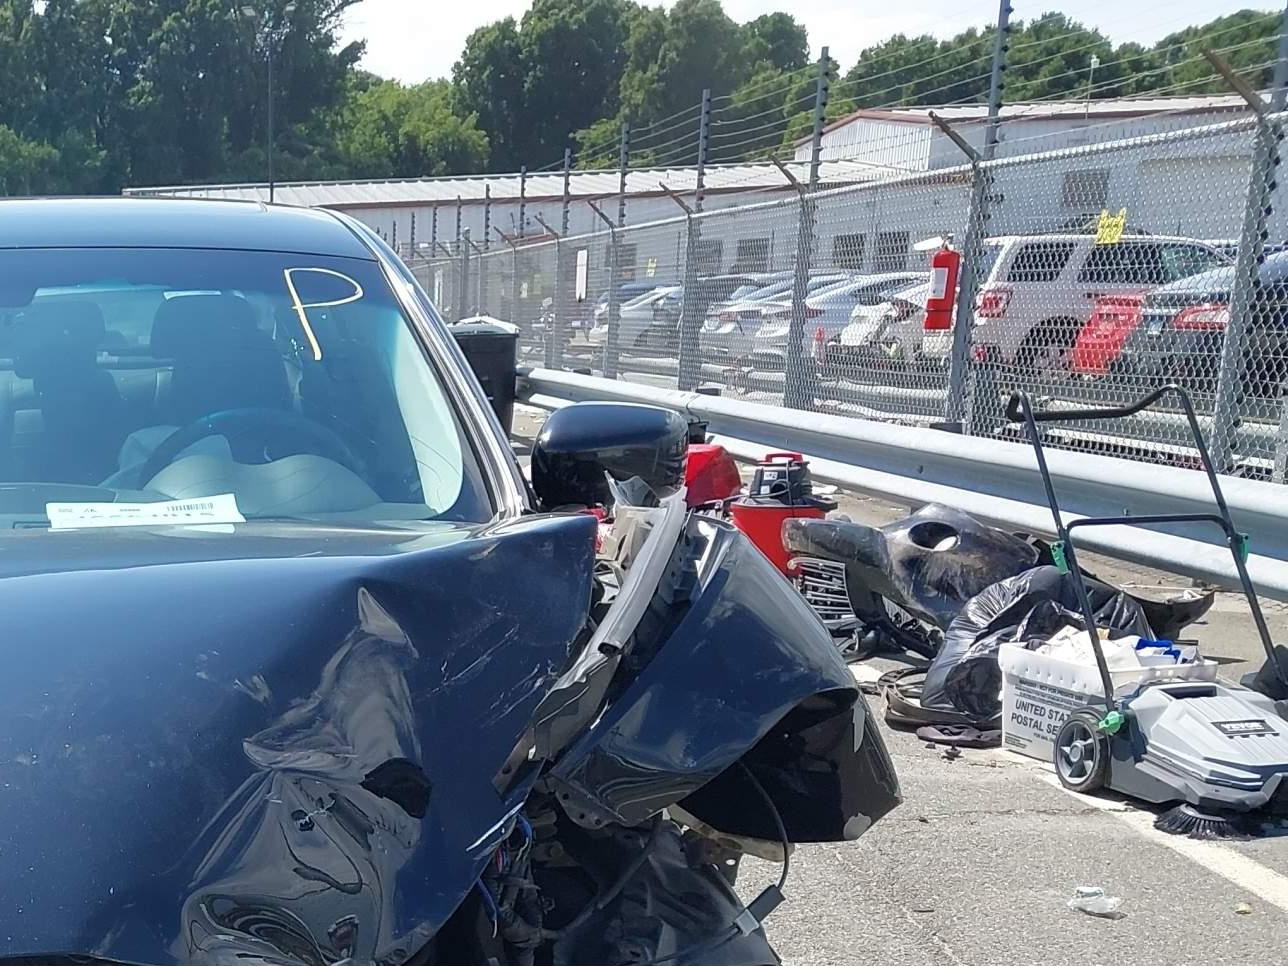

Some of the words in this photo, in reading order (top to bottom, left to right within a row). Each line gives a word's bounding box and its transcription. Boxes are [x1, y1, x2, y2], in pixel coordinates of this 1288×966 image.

[283, 267, 364, 360] P
[1011, 712, 1044, 732] POSTAL
[1015, 698, 1046, 717] UNITED
[1047, 708, 1071, 722] STAT
